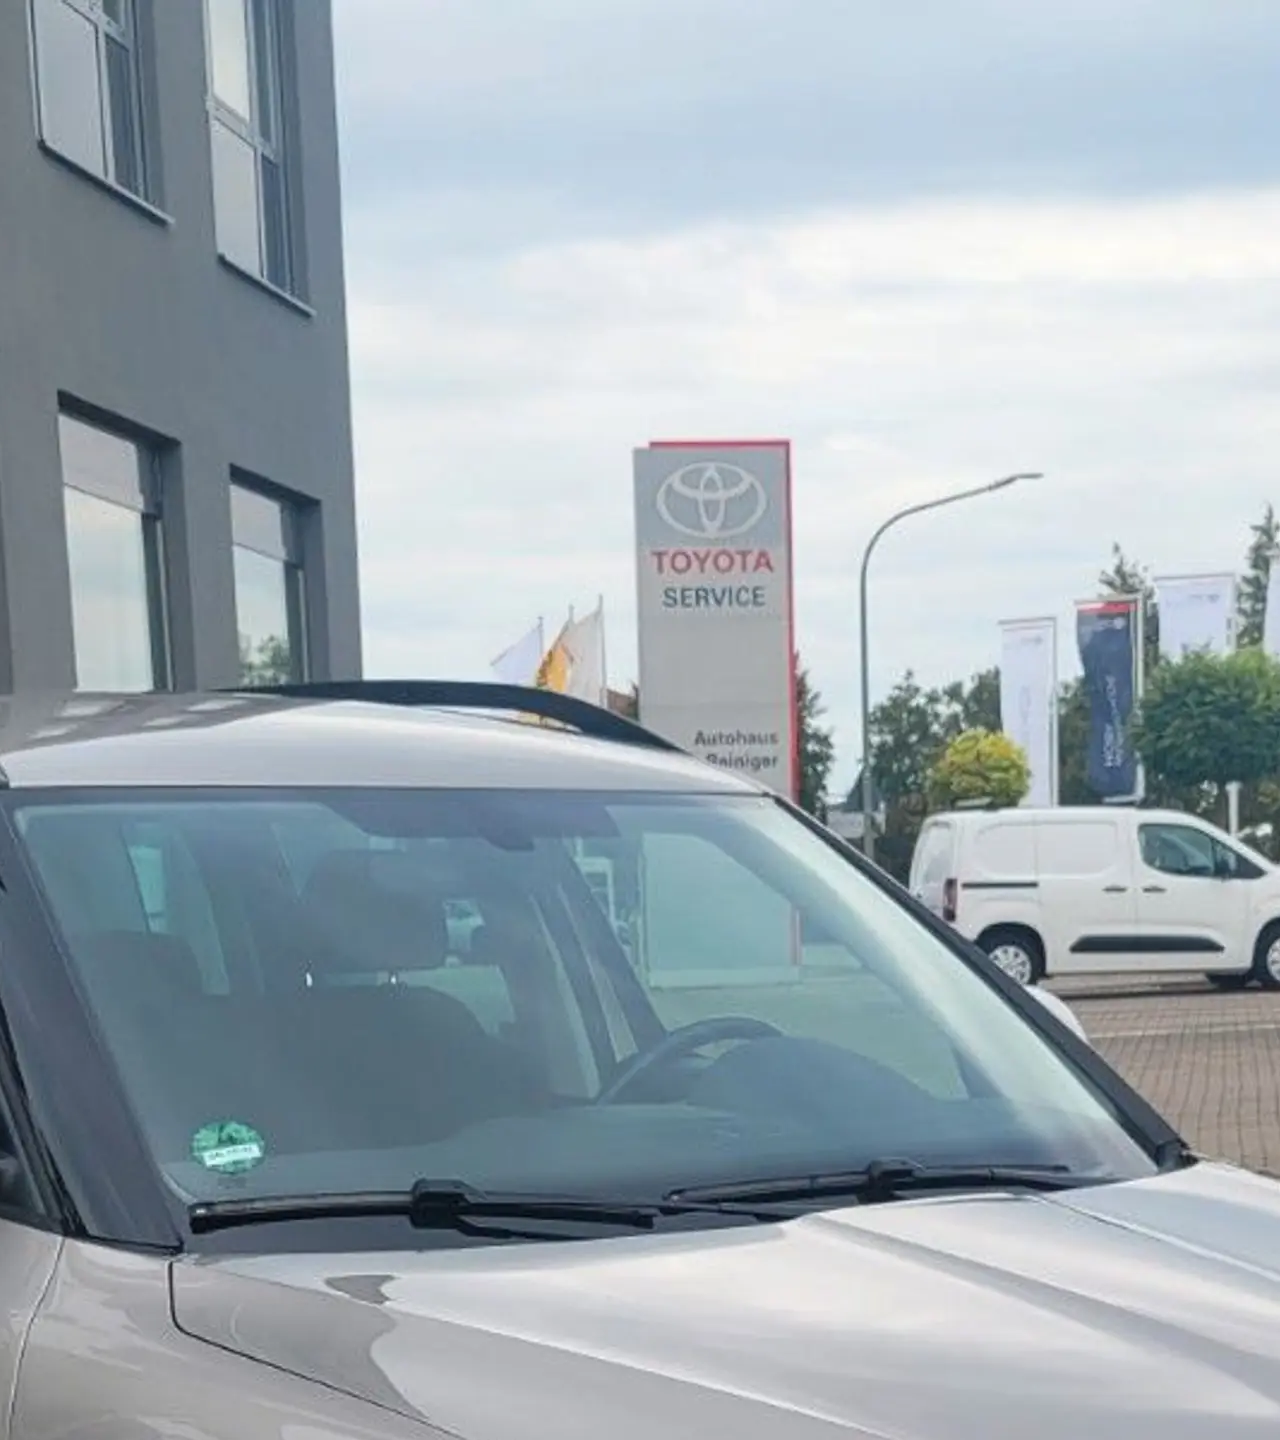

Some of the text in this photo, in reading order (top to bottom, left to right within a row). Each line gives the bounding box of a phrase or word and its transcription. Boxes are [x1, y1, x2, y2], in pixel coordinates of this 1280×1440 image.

[651, 550, 773, 574] TOYOTA
[662, 585, 766, 608] SERVICE
[695, 729, 778, 746] Autohaus
